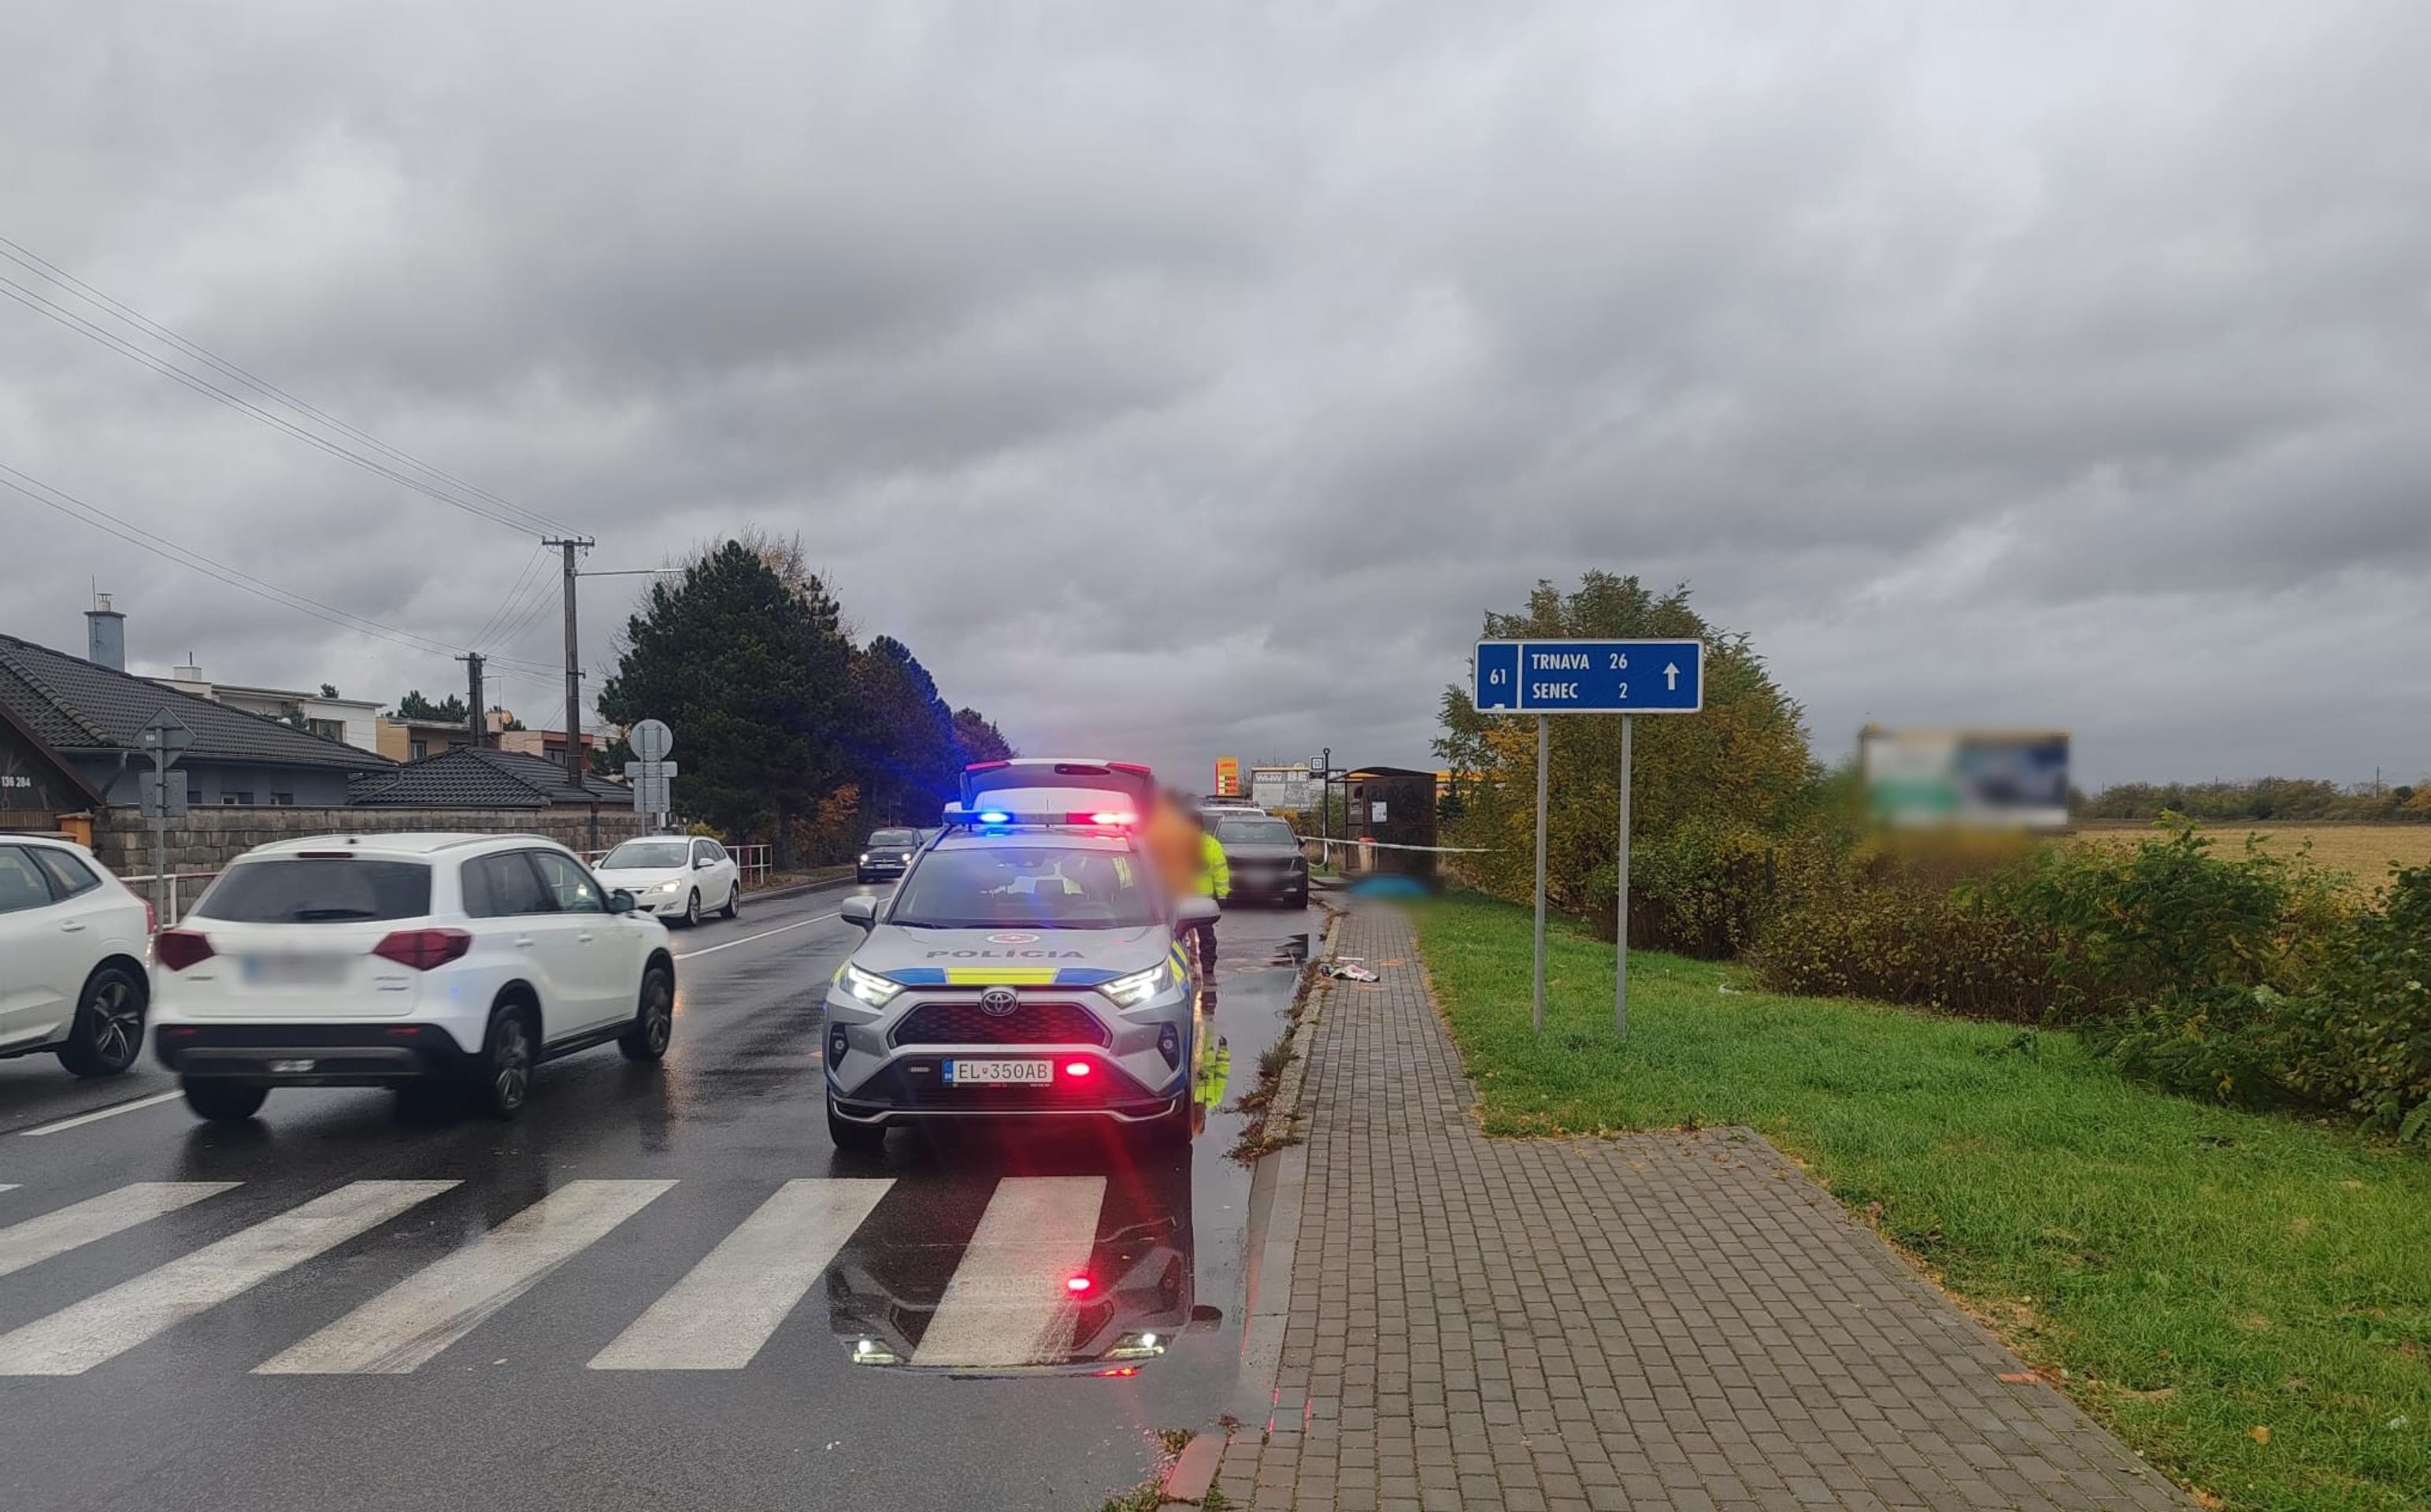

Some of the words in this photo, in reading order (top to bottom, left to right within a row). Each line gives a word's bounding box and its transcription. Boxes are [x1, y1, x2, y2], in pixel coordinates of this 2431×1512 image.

[1531, 653, 1590, 669] TRNAVA
[1609, 653, 1628, 669] 26
[1489, 668, 1506, 685] 61
[1532, 682, 1578, 699] SENEC
[1618, 682, 1628, 699] 2
[958, 1063, 980, 1080] EL
